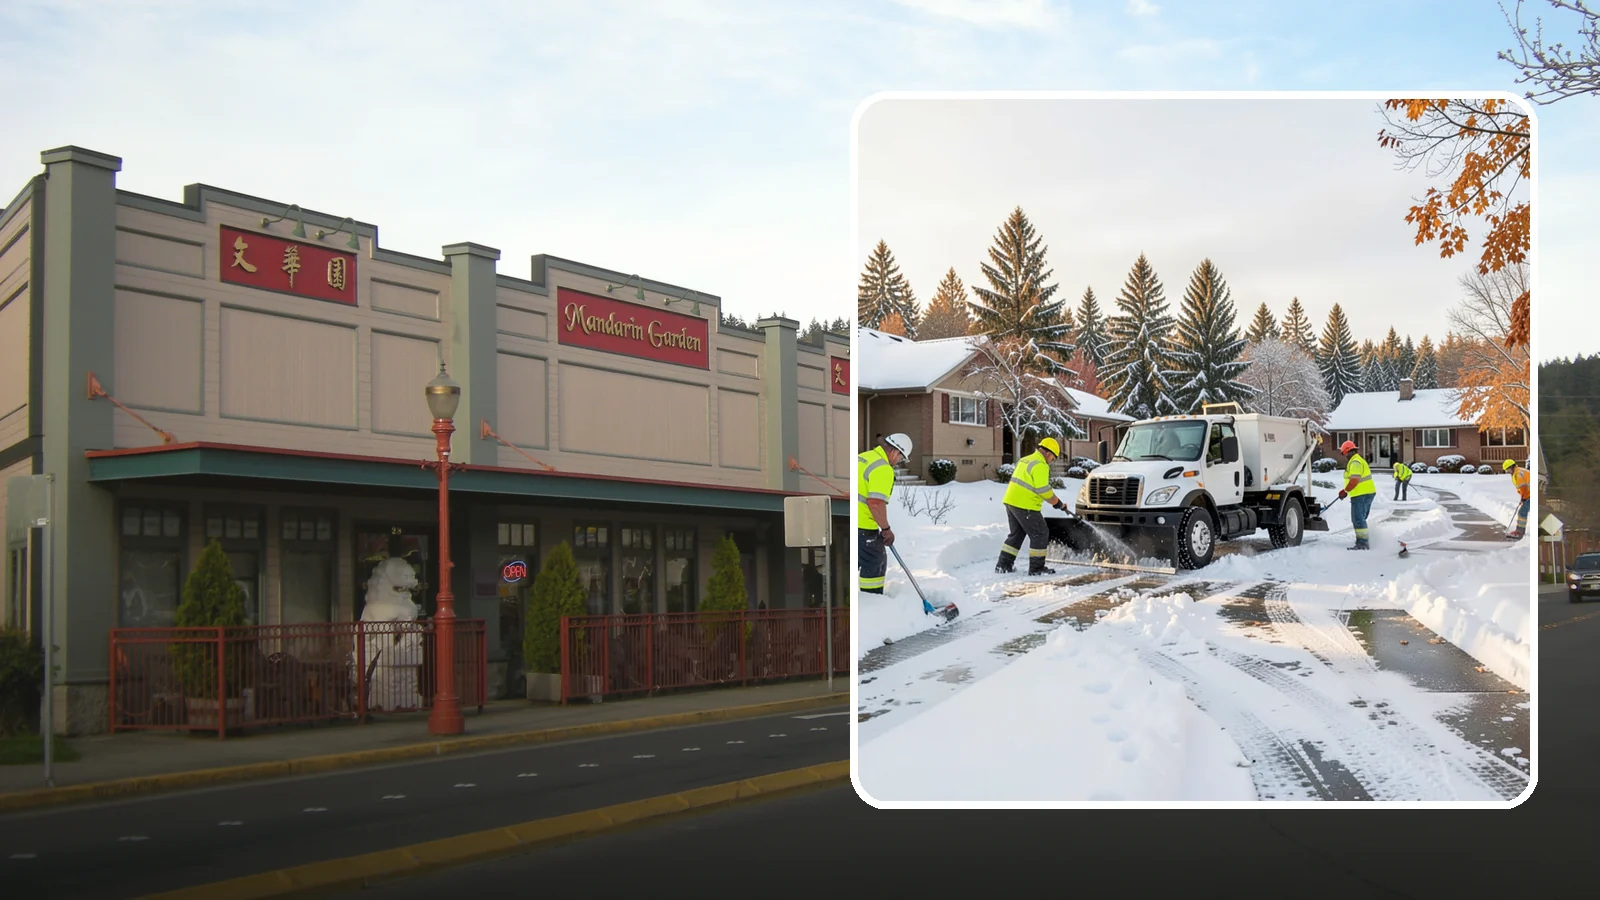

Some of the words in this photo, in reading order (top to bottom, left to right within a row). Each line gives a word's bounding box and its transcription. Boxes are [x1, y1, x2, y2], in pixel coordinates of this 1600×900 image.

[564, 302, 645, 341] Mandarin
[647, 320, 702, 352] Garden
[503, 565, 527, 578] OPEN
